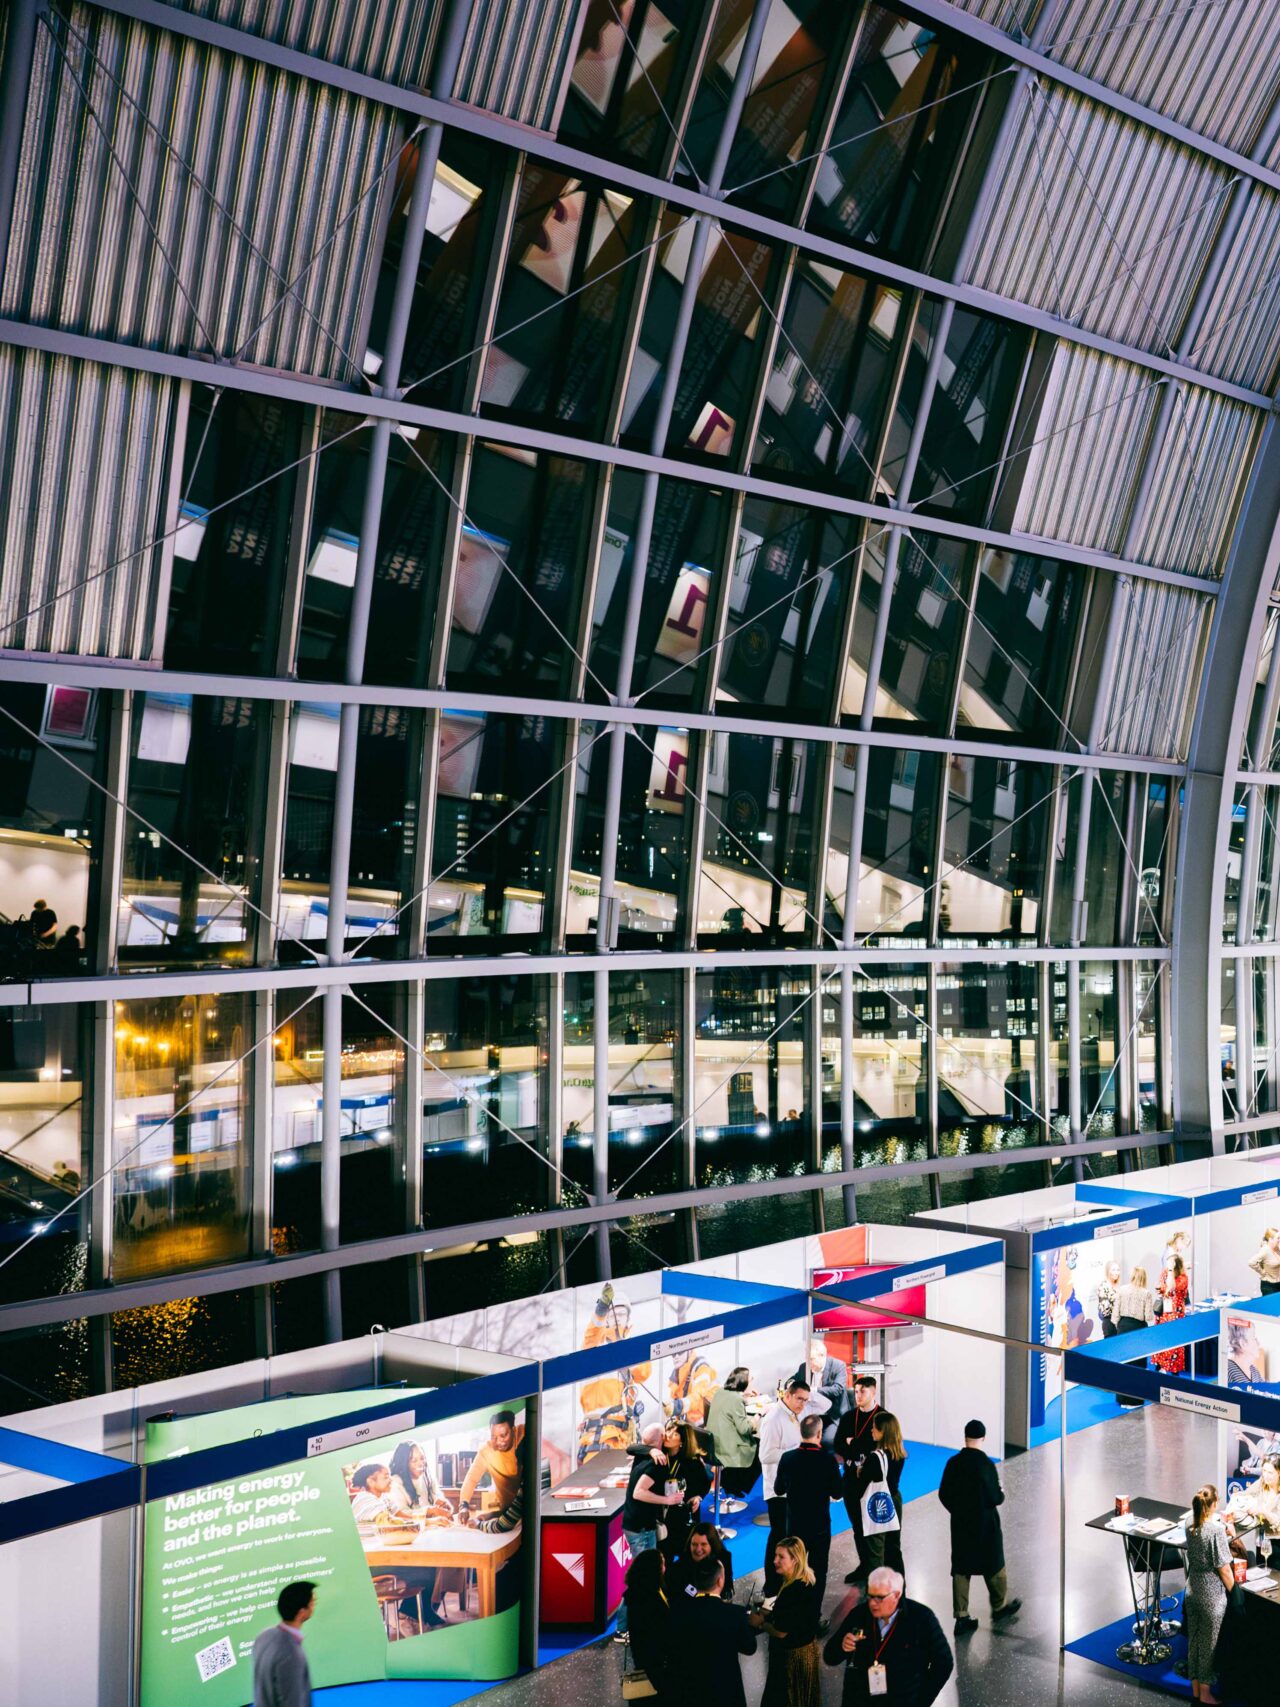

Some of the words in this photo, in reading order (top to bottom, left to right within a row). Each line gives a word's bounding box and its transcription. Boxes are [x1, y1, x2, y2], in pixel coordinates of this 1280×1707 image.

[668, 1340, 688, 1349] Northern
[1174, 1395, 1194, 1405] National
[1194, 1400, 1211, 1411] Energy
[1212, 1404, 1228, 1413] Action
[315, 1437, 323, 1445] 10
[355, 1428, 370, 1437] OVO
[165, 1485, 235, 1513] Making
[238, 1471, 306, 1494] energy
[164, 1507, 222, 1532] better
[225, 1499, 253, 1516] for
[255, 1485, 321, 1513] people
[163, 1529, 200, 1552] and
[202, 1520, 233, 1541] the
[236, 1507, 302, 1536] planet.
[162, 1562, 172, 1570] At
[195, 1554, 206, 1562] we
[207, 1548, 226, 1557] want
[227, 1541, 254, 1553] energy
[264, 1535, 283, 1544] work
[284, 1532, 295, 1540] for
[296, 1527, 334, 1539] everyone.
[162, 1577, 175, 1586] We
[177, 1572, 198, 1583] make
